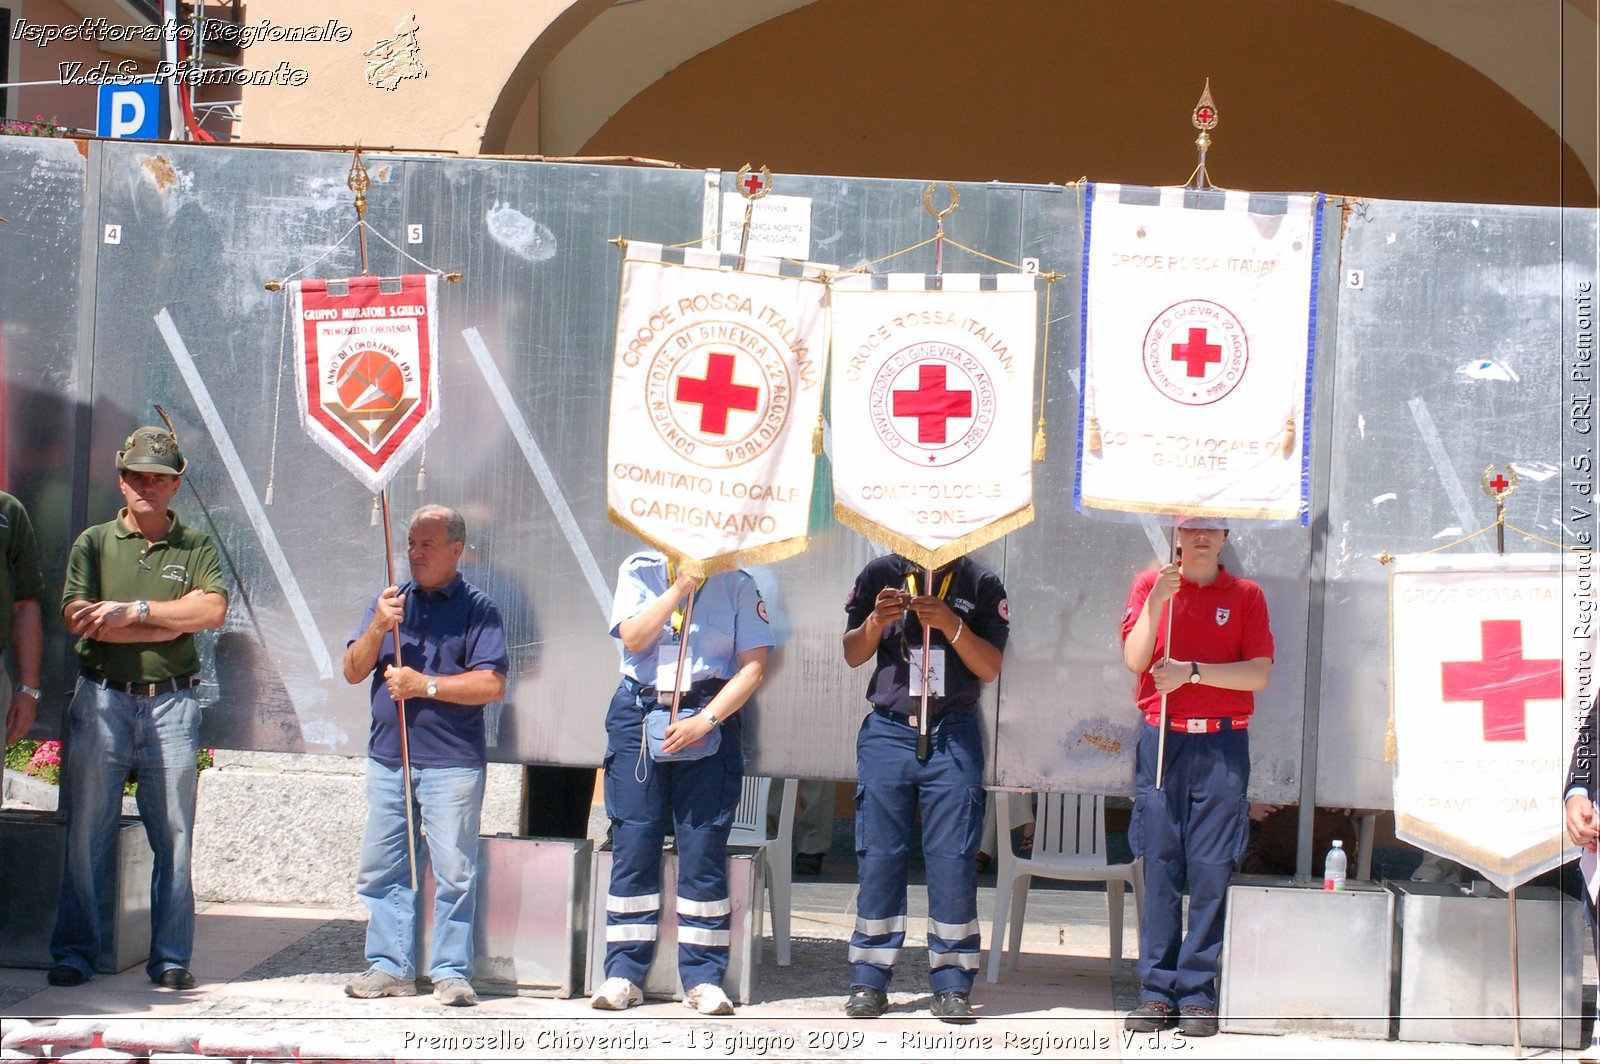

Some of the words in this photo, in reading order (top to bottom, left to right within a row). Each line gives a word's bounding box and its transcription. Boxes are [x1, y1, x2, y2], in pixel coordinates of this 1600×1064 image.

[111, 91, 146, 139] P
[107, 228, 118, 241] 4
[412, 228, 421, 240] 5
[1026, 261, 1036, 274] 2
[1350, 273, 1360, 285] 3
[304, 309, 338, 321] GRUPPO
[342, 306, 386, 319] MURATORI
[389, 305, 426, 317] S.GIULIO
[1162, 316, 1173, 329] DI
[1174, 306, 1220, 321] GINEVRA
[371, 324, 412, 336] CHIOVENDA
[1221, 318, 1234, 332] 22
[622, 304, 676, 369] CROCE
[677, 291, 753, 317] ROSSA
[757, 304, 817, 392] ITALIANA
[675, 332, 693, 349] DI
[699, 325, 768, 359] GINEVRA
[845, 325, 892, 383] CROCE
[892, 310, 957, 330] ROSSA
[960, 317, 1020, 382] ITALIANA
[327, 361, 339, 386] ANNO
[338, 351, 348, 361] DI
[349, 340, 400, 358] FONDAZIONE
[400, 361, 413, 383] 1958
[894, 352, 909, 368] DI
[909, 344, 963, 364] GINEVRA
[961, 357, 980, 373] 22
[1151, 329, 1184, 396] CONVENZIONE
[1225, 333, 1243, 382] AGOSTO
[765, 359, 784, 379] 22
[973, 372, 993, 425] AGOSTO
[1206, 381, 1227, 397] 1864
[650, 349, 697, 456] CONVENZIONE
[759, 383, 787, 441] AGOSTO
[872, 363, 901, 450] CONVENZIONE
[724, 432, 763, 463] 1864
[963, 426, 985, 450] 1864
[613, 463, 713, 495] COMITATO
[720, 481, 801, 504] LOCALE
[630, 497, 777, 535] CARIGNANO
